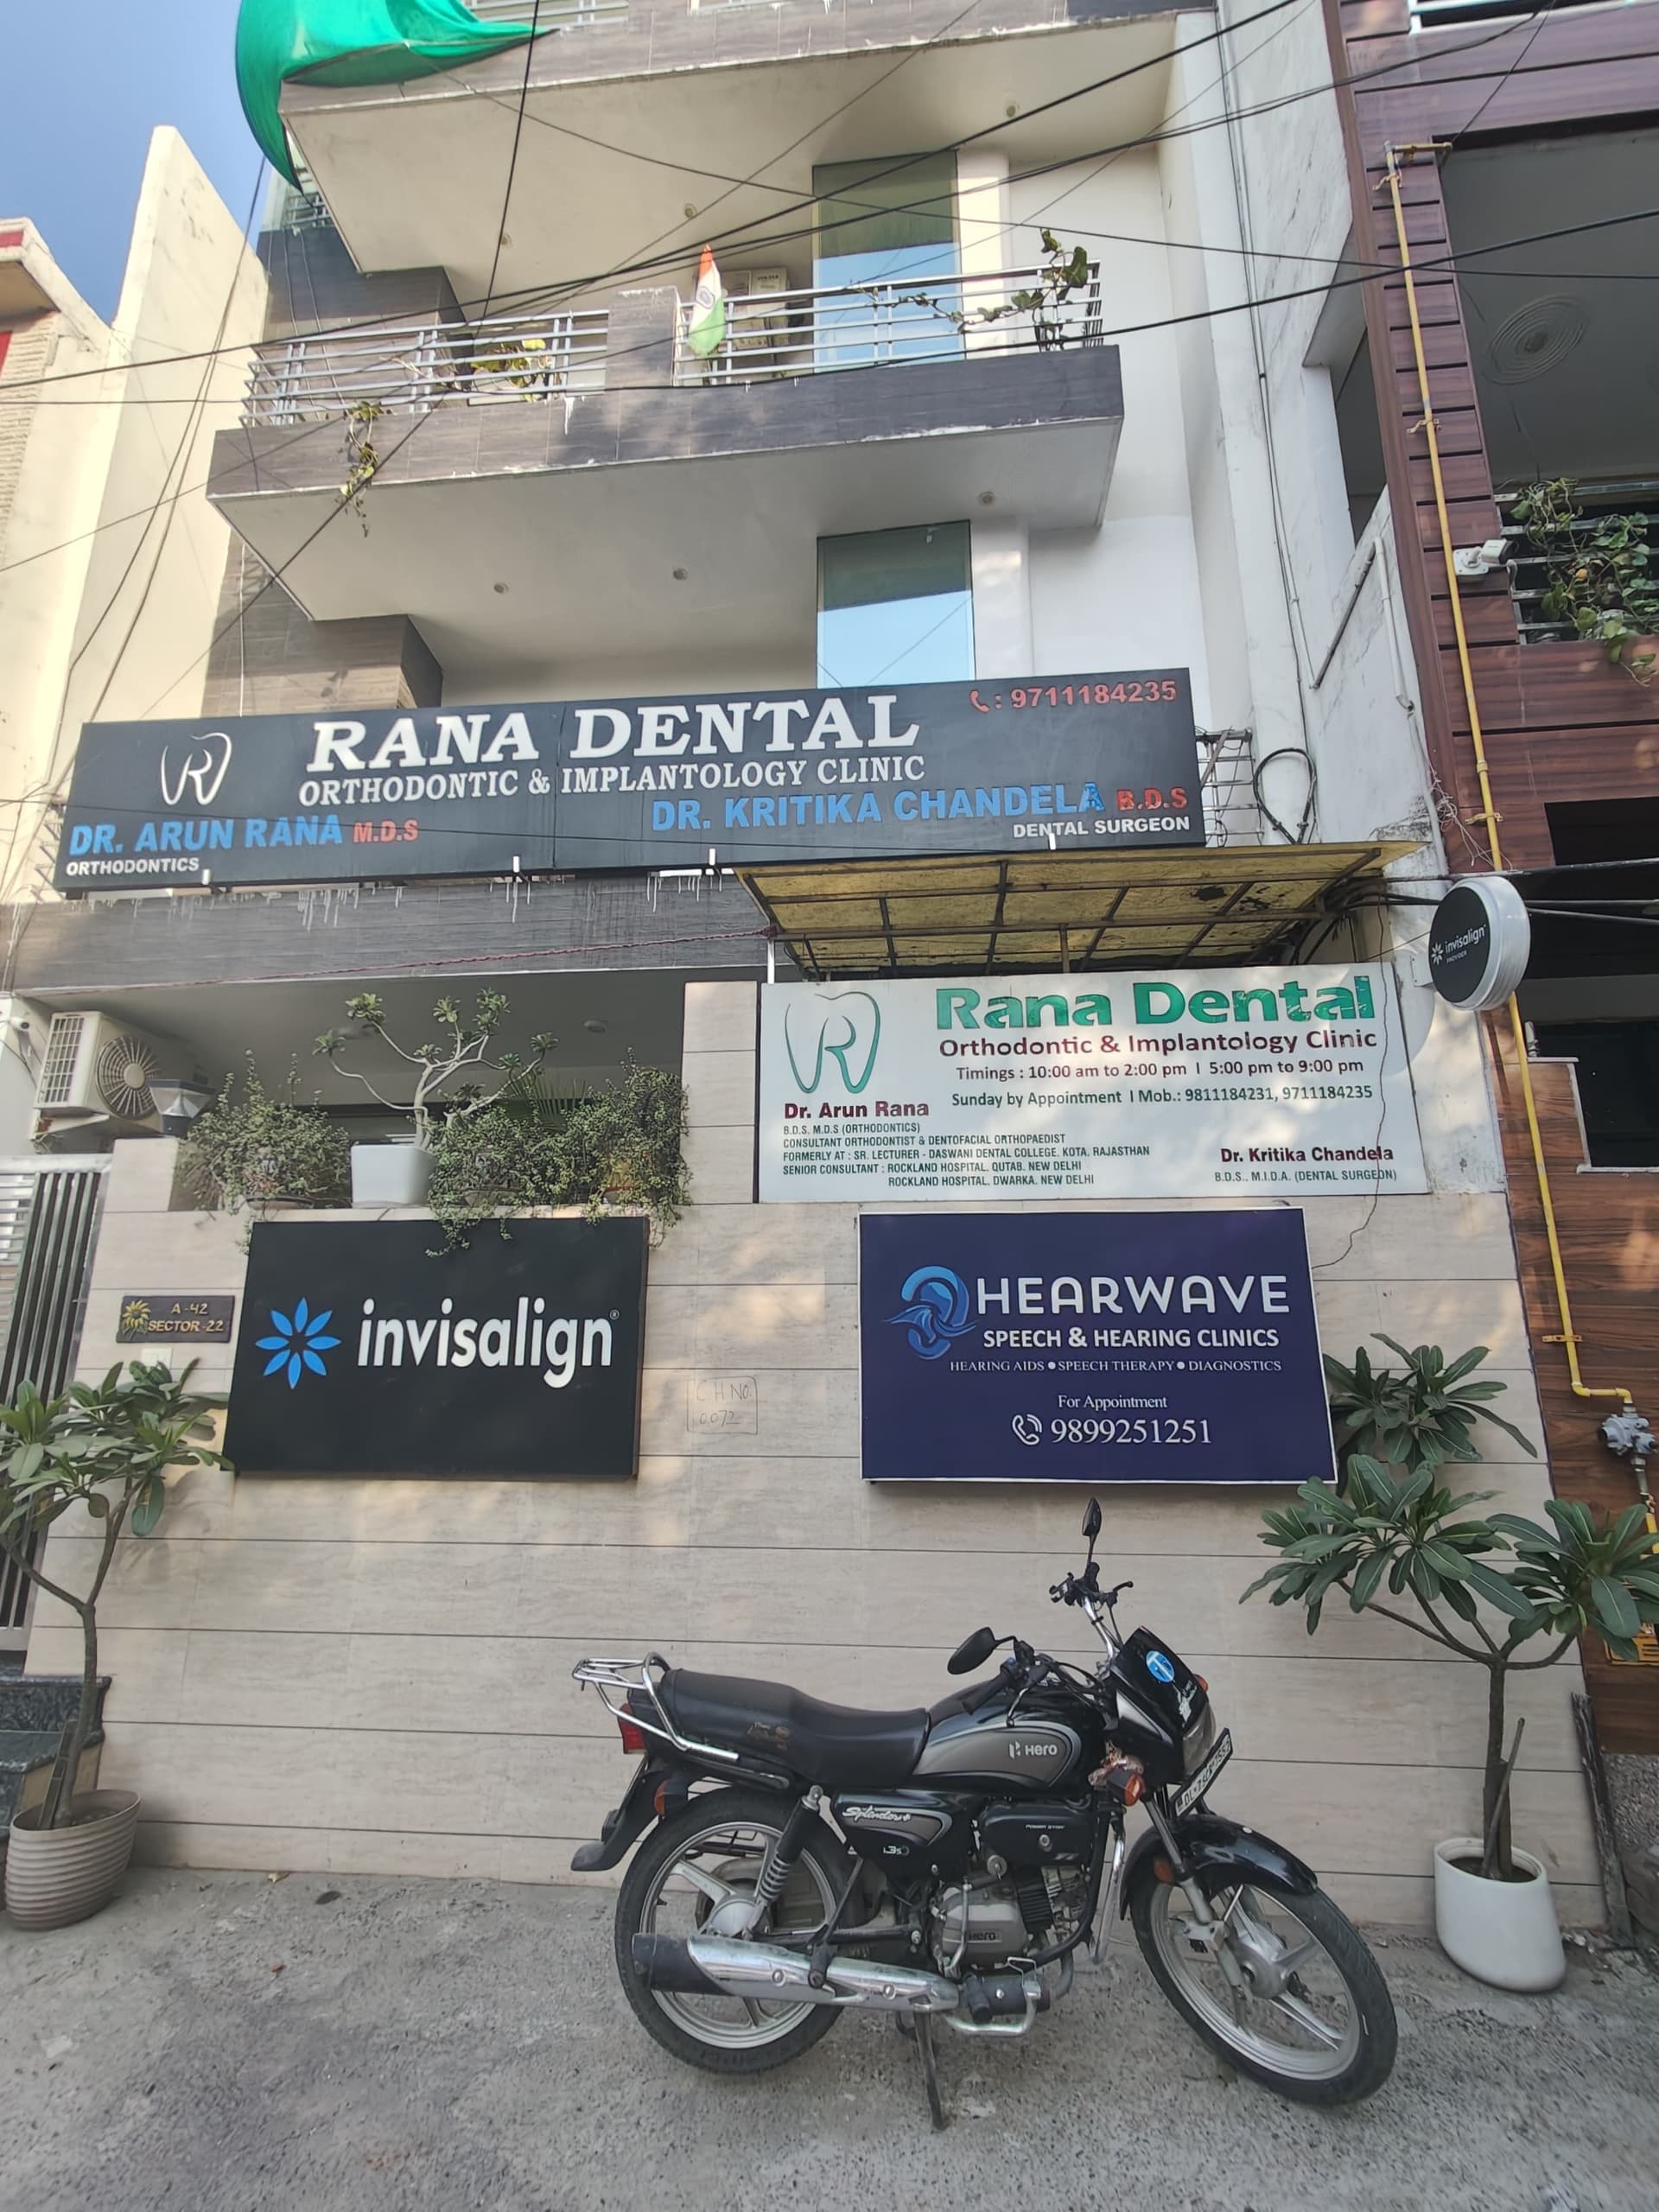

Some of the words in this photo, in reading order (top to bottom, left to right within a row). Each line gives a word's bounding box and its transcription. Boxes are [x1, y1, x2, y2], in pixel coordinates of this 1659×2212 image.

[1010, 680, 1178, 709] 9711184235
[307, 712, 538, 772] RANA
[569, 695, 920, 760] DENTAL
[298, 768, 518, 807] ORTHODONTIC
[528, 770, 551, 796] &
[561, 760, 807, 794] IMPLANTOLOGY
[817, 755, 925, 785] CLINIC
[652, 799, 711, 830] DR.
[725, 792, 883, 828] KRITIKA
[893, 783, 1104, 821] CHANDELA
[1116, 788, 1188, 810] B.D.S
[70, 824, 124, 856] DR.
[135, 819, 233, 852] ARUN
[245, 815, 343, 849] RANA
[353, 820, 418, 843] M.D.S
[1013, 820, 1089, 837] DENTAL
[1094, 816, 1189, 835] SURGEON
[66, 858, 199, 875] ORTHODONTICS
[936, 988, 1112, 1030] Rana
[1133, 976, 1376, 1026] Dental
[939, 1036, 1093, 1057] Orthodontic
[1100, 1035, 1121, 1052] &
[1128, 1032, 1298, 1056] Implantology
[1306, 1029, 1377, 1049] Clinic
[957, 1066, 1015, 1082] Timings
[1028, 1065, 1071, 1078] 10:00
[1075, 1067, 1099, 1077] am
[1104, 1065, 1119, 1077] to
[1124, 1063, 1157, 1077] 2:00
[1162, 1064, 1186, 1077] pm
[1210, 1061, 1243, 1074] 5:00
[1249, 1064, 1273, 1077] pm
[1278, 1061, 1294, 1073] to
[1299, 1059, 1333, 1073] 9:00
[1338, 1060, 1363, 1074] pm
[952, 1092, 1002, 1108] Sunday
[1007, 1092, 1023, 1108] by
[1027, 1090, 1122, 1107] Appointment
[1282, 1085, 1373, 1100] 9711184235
[785, 1103, 811, 1119] Dr.
[819, 1103, 868, 1118] Arun
[875, 1101, 929, 1117] Rana
[842, 1122, 920, 1135] (ORTHODONTICS)
[783, 1138, 842, 1148] CONSULTANT
[844, 1136, 915, 1147] ORTHODONTIST
[918, 1135, 925, 1146] &
[928, 1135, 991, 1146] DENTOFACIAL
[995, 1134, 1065, 1144] ORTHOPAEDIST
[783, 1151, 831, 1161] FORMERLY
[834, 1151, 846, 1160] AT
[872, 1149, 919, 1160] LECTURER
[929, 1148, 973, 1160] DASWANI
[976, 1147, 1012, 1159] DENTAL
[1093, 1146, 1150, 1157] RAJASTHAN
[1221, 1147, 1243, 1162] Dr.
[1249, 1147, 1306, 1162] Kritika
[1312, 1145, 1394, 1161] Chandela
[783, 1165, 817, 1175] SENIOR
[820, 1164, 879, 1174] CONSULTANT
[887, 1163, 938, 1173] ROCKLAND
[1028, 1160, 1051, 1171] NEW
[1053, 1160, 1082, 1171] DELHI
[1295, 1170, 1338, 1183] (DENTAL
[888, 1176, 939, 1186] ROCKLAND
[1040, 1174, 1062, 1185] NEW
[1065, 1173, 1094, 1185] DELHI
[976, 1275, 1290, 1314] HEARWAVE
[983, 1329, 1061, 1349] SPEECH
[1068, 1326, 1087, 1349] &
[1094, 1329, 1191, 1348] HEARING
[1197, 1328, 1280, 1347] CLINICS
[950, 1361, 1010, 1372] HEARING
[1014, 1361, 1045, 1372] AIDS
[1058, 1361, 1109, 1372] SPEECH
[1112, 1360, 1175, 1372] THERAPY
[1189, 1360, 1282, 1372] DIAGNOSTICS
[1058, 1395, 1080, 1408] For
[1083, 1394, 1167, 1412] Appointment
[1051, 1418, 1212, 1445] 9899251251
